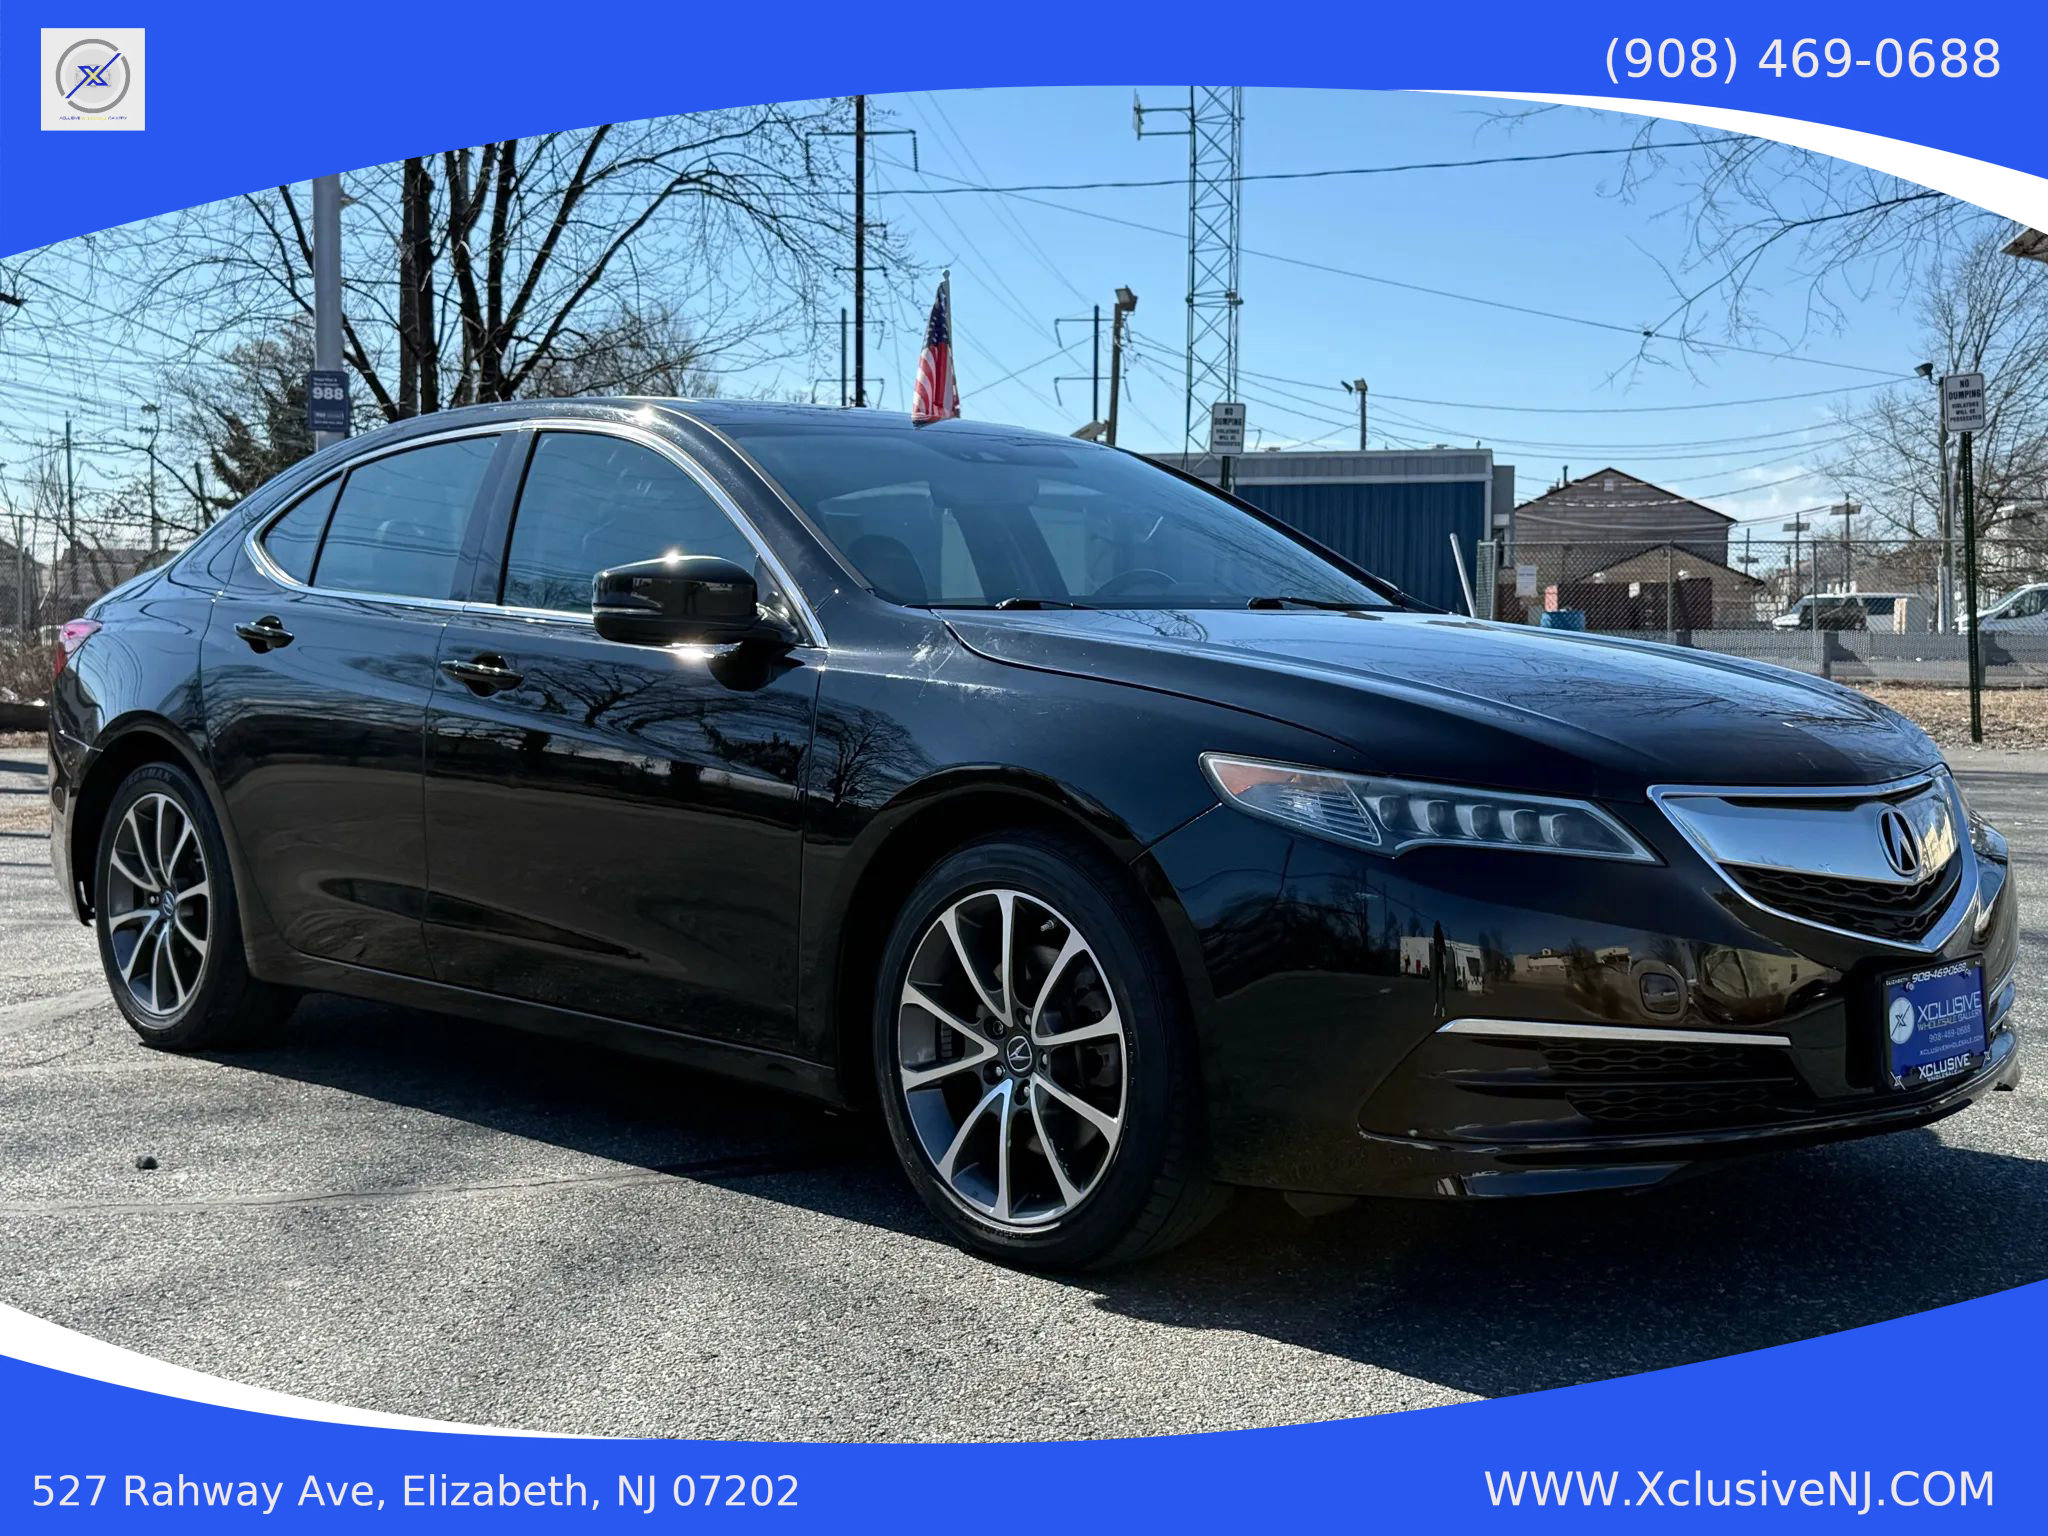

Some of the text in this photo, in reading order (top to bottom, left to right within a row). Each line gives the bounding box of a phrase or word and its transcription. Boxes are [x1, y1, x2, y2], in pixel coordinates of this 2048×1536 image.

[1960, 379, 1969, 387] NO
[313, 387, 344, 401] 988
[1948, 390, 1982, 401] DUMPING
[1952, 401, 1979, 409] VIOLATORS
[1918, 991, 1982, 1022] XCLUSIVE
[1917, 1014, 1958, 1031] WHOLESALE
[1918, 1053, 1971, 1080] XCLUSIVE
